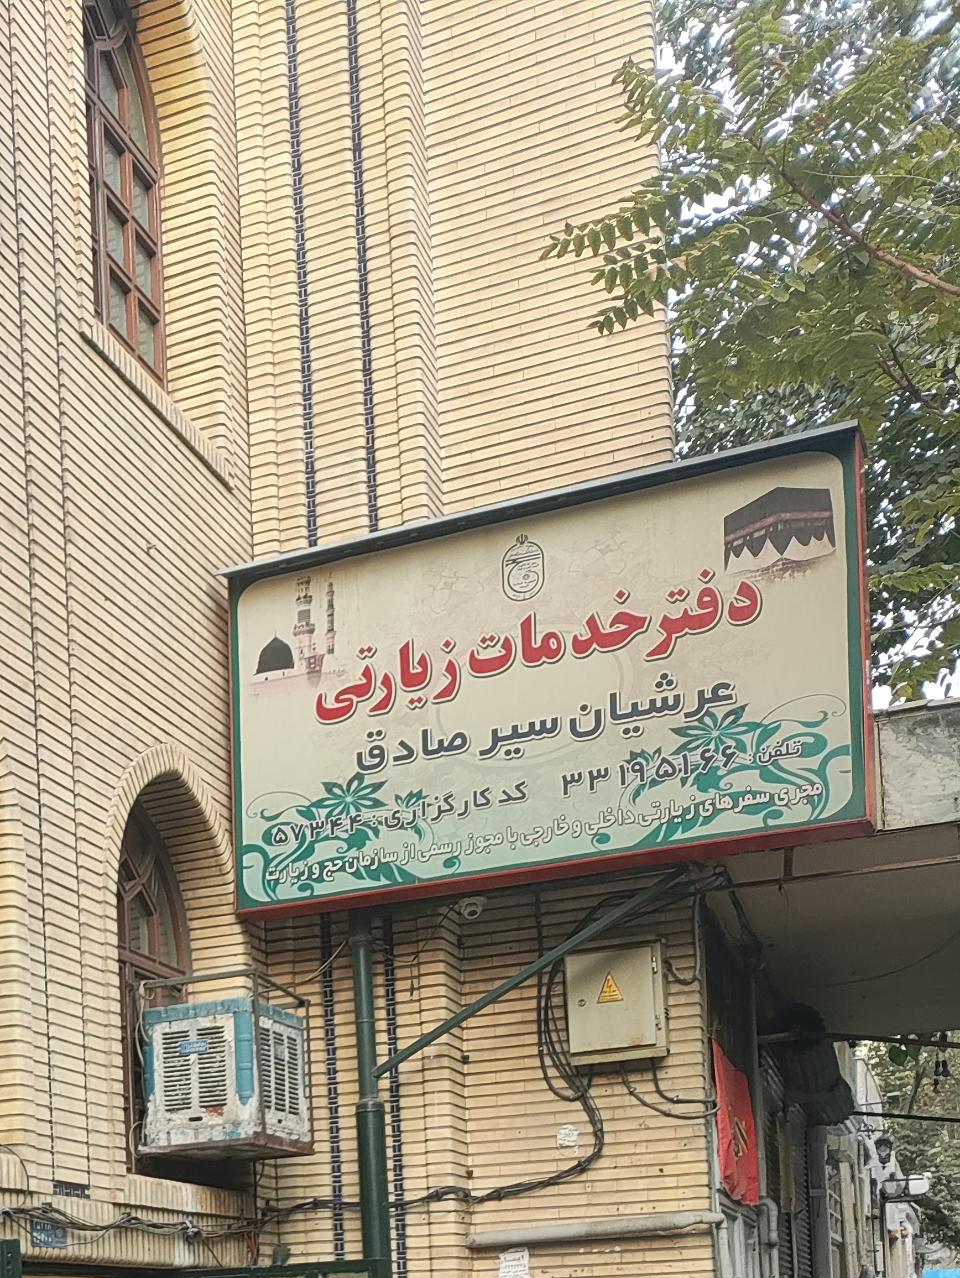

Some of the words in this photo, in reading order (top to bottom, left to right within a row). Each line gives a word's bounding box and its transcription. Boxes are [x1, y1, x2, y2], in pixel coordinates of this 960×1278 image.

[644, 567, 762, 661] دفتر
[467, 588, 650, 677] خدمات
[314, 638, 462, 724] زیارتی
[570, 672, 736, 739] عرشیان
[356, 725, 471, 772] صادق
[479, 712, 561, 759] سیر
[561, 744, 738, 797] ۳۳۱۹۵۱۶۶
[498, 780, 528, 804] کد
[774, 782, 823, 808] مجری
[585, 807, 636, 834] داخلی
[639, 796, 697, 827] زیارتی
[273, 813, 363, 846] ۵۷۳۴۴
[464, 830, 503, 854] مجوز
[506, 826, 519, 849] با
[520, 816, 570, 846] خارجی
[571, 822, 582, 838] و
[345, 849, 399, 873] سازمان
[401, 843, 416, 865] از
[418, 839, 461, 860] رسمی
[265, 862, 309, 887] زیارت
[312, 863, 320, 879] و
[322, 858, 343, 883] حج
